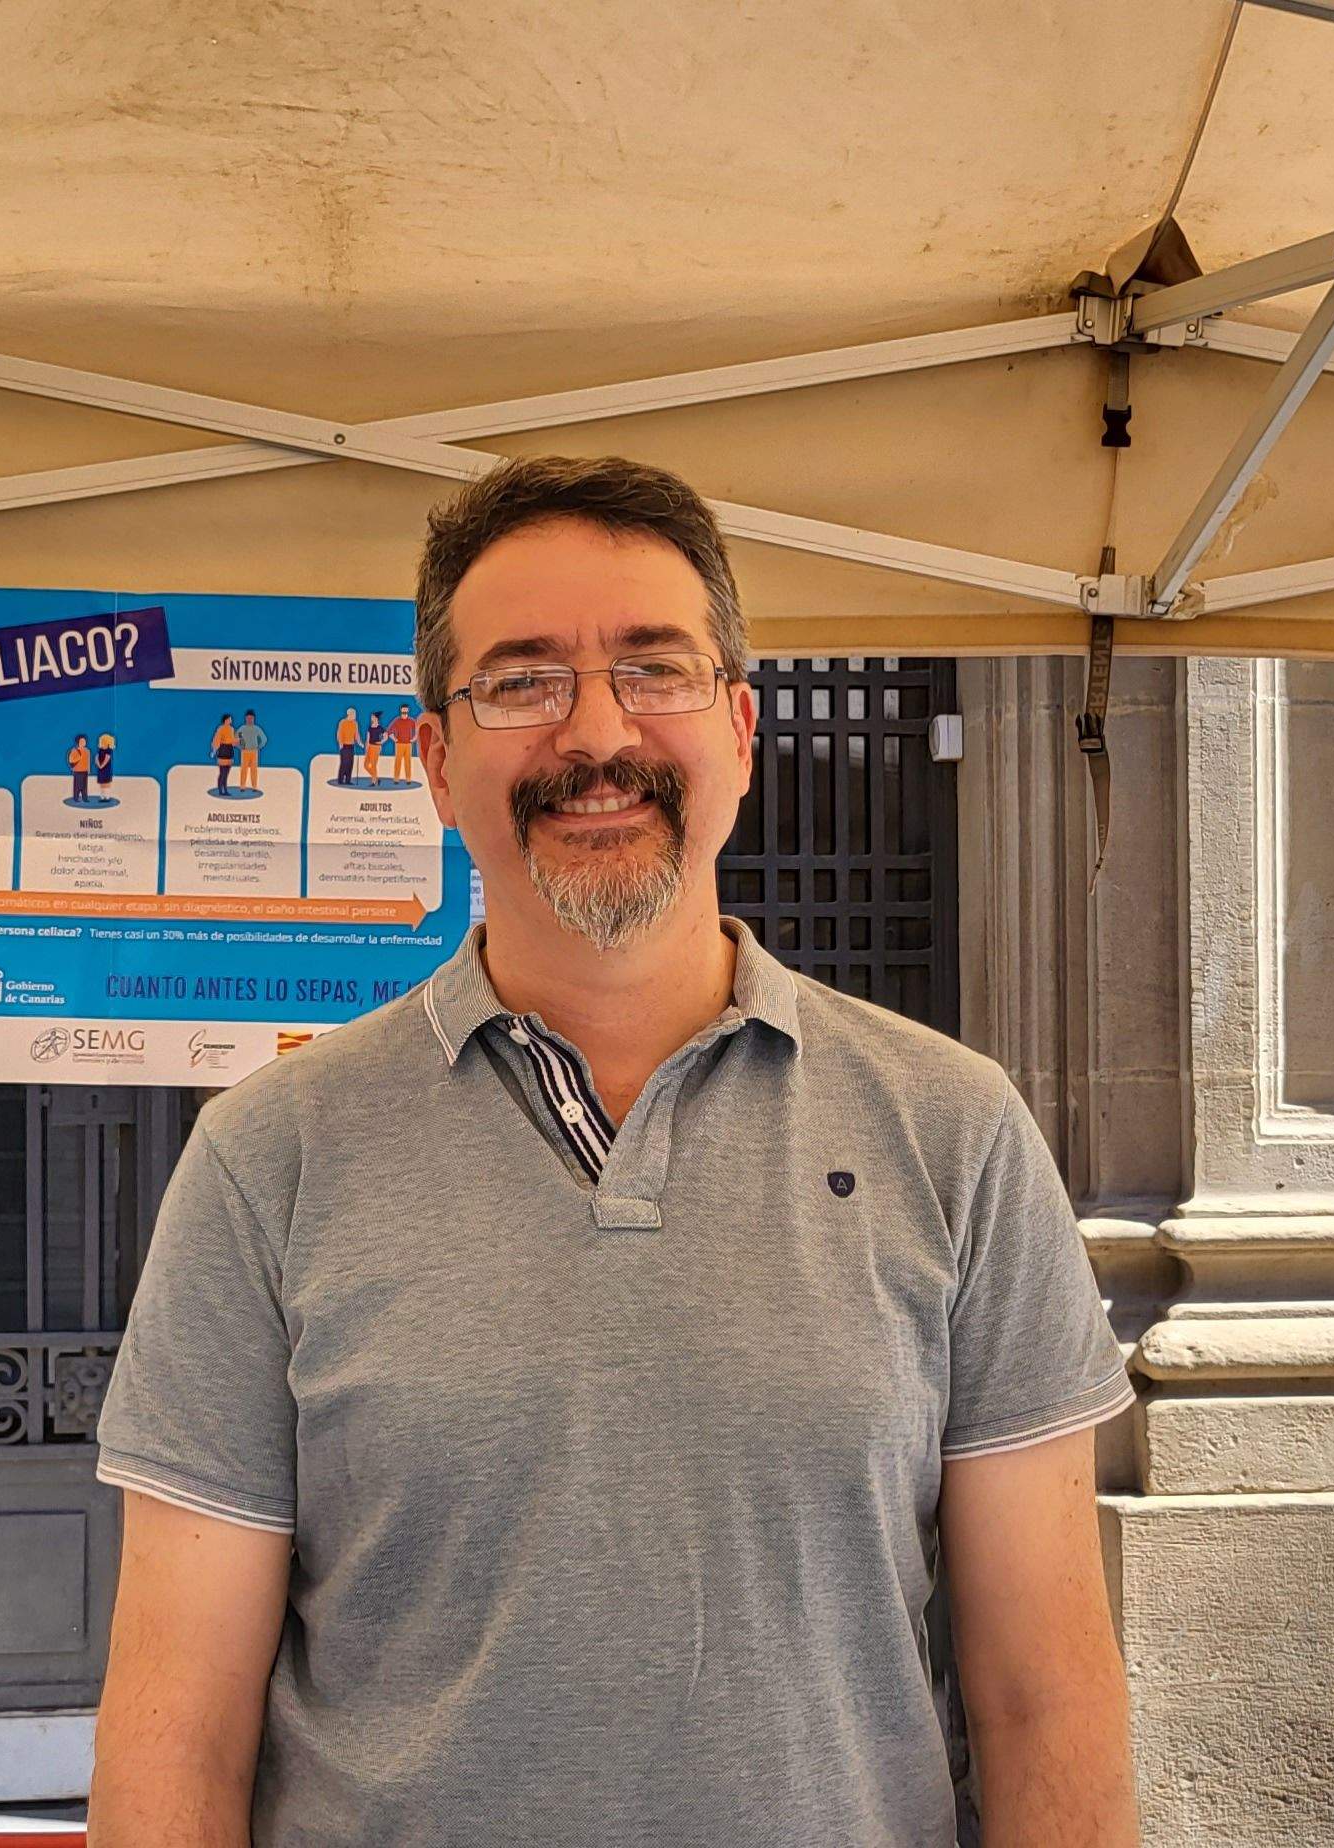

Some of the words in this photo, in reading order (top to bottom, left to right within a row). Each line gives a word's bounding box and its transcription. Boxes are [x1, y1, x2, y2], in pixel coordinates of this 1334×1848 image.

[211, 657, 302, 682] SÍNTOMAS
[308, 662, 341, 683] POR
[348, 663, 412, 685] EDADES
[360, 803, 392, 812] ADULTOS
[80, 818, 103, 829] NIÑOS
[207, 813, 261, 823] ADOLESCENTES
[53, 900, 68, 909] en
[71, 899, 123, 913] cualquier
[165, 902, 181, 912] sin
[254, 905, 263, 914] el
[268, 905, 295, 915] daño
[298, 906, 349, 917] intestinal
[352, 907, 397, 918] persiste
[90, 929, 122, 939] Tienes
[124, 929, 144, 939] casi
[147, 931, 160, 940] un
[163, 930, 184, 940] 30%
[187, 931, 209, 941] más
[211, 931, 224, 941] de
[227, 932, 293, 943] posibilidades
[295, 933, 309, 943] de
[311, 933, 366, 944] desarrollar
[369, 934, 378, 944] la
[380, 935, 443, 946] enfermedad
[5, 980, 55, 992] Gobierno
[107, 975, 187, 999] CUANTO
[195, 976, 257, 1001] ANTES
[266, 978, 288, 1001] LO
[296, 978, 364, 1007] SEPAS,
[5, 994, 17, 1004] de
[19, 994, 65, 1004] Canarias
[73, 1028, 145, 1051] SEMG
